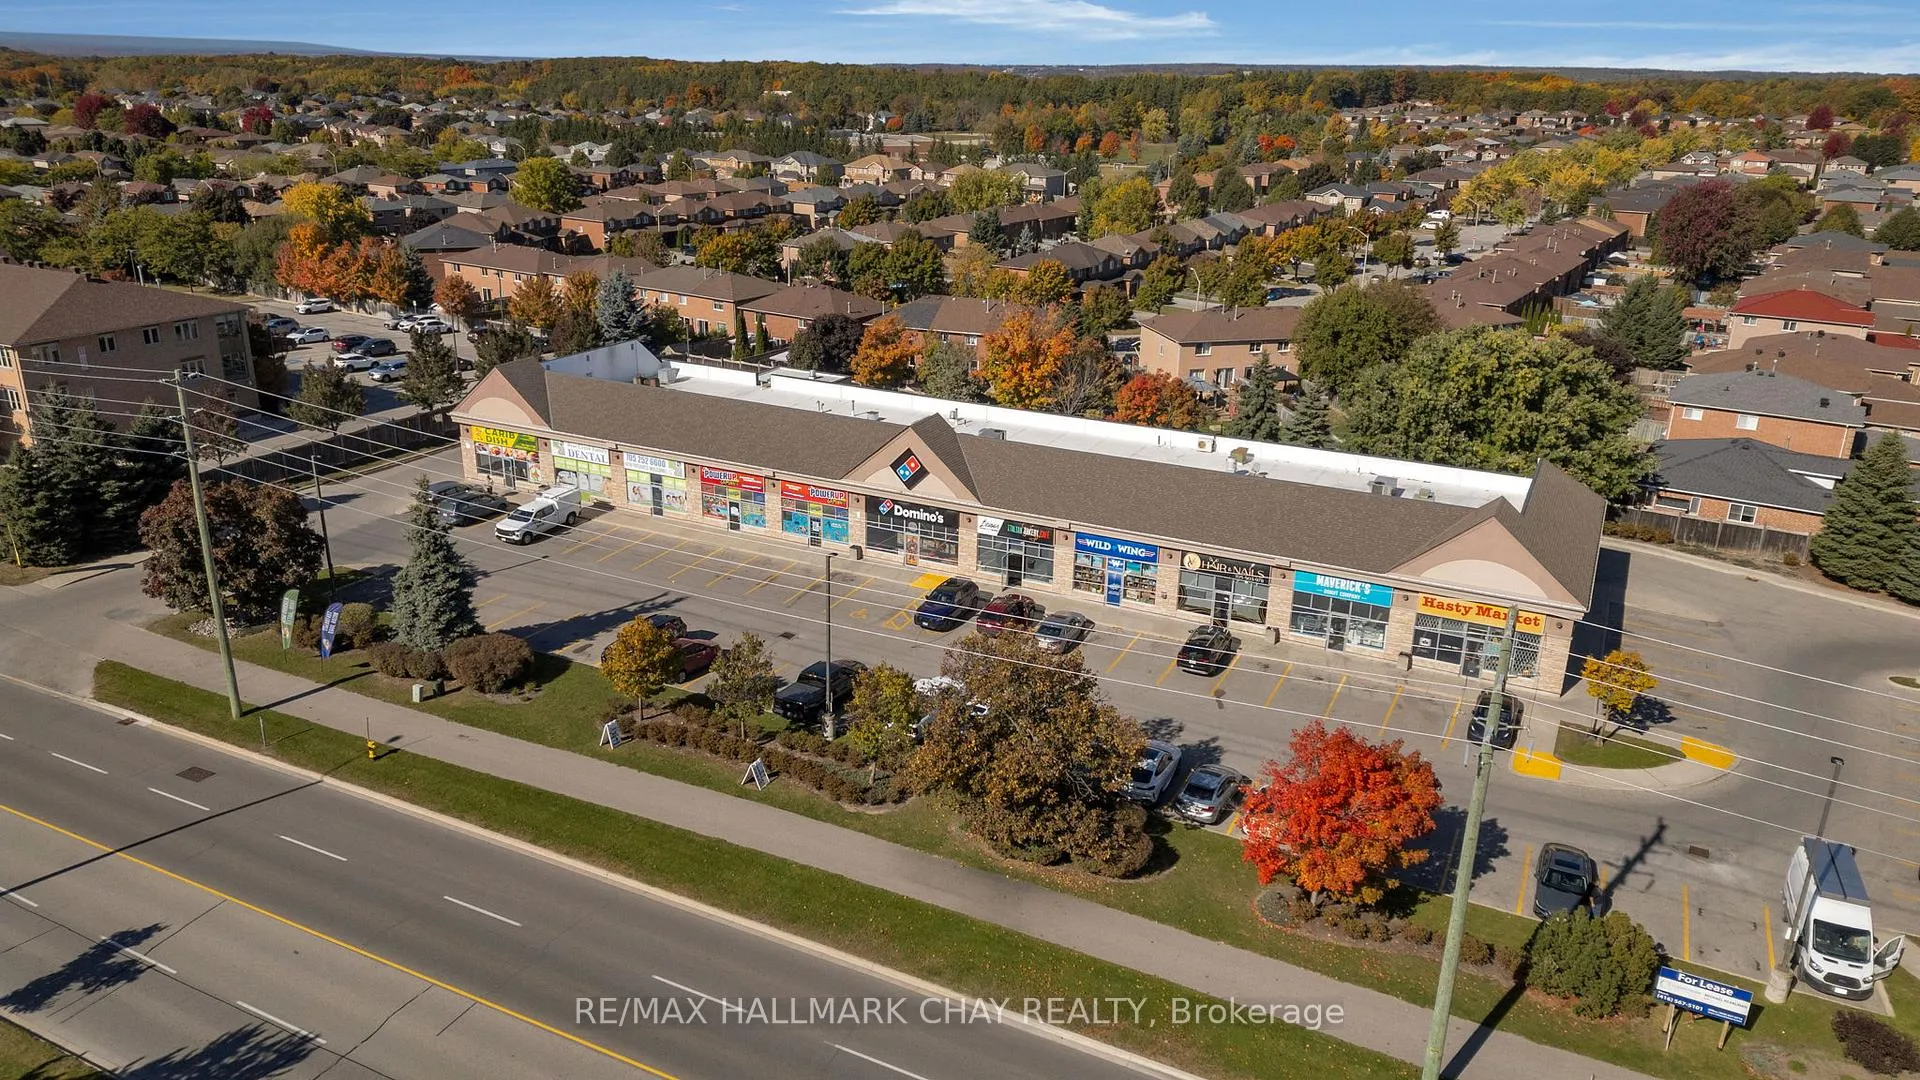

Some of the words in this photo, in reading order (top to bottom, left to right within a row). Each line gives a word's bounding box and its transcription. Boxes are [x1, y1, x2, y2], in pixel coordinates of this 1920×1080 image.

[485, 428, 515, 439] CARIB
[486, 436, 508, 445] DISH
[568, 449, 608, 463] DENTAL
[894, 504, 944, 523] Domino's
[1086, 539, 1111, 550] WILD
[1117, 544, 1146, 557] WING
[1201, 561, 1227, 573] HAIR
[1233, 566, 1265, 578] NAILS
[1315, 575, 1371, 595] MAVERICK'S
[1421, 596, 1473, 615] Hasty
[1677, 973, 1698, 985] For
[1700, 980, 1734, 996] Lease
